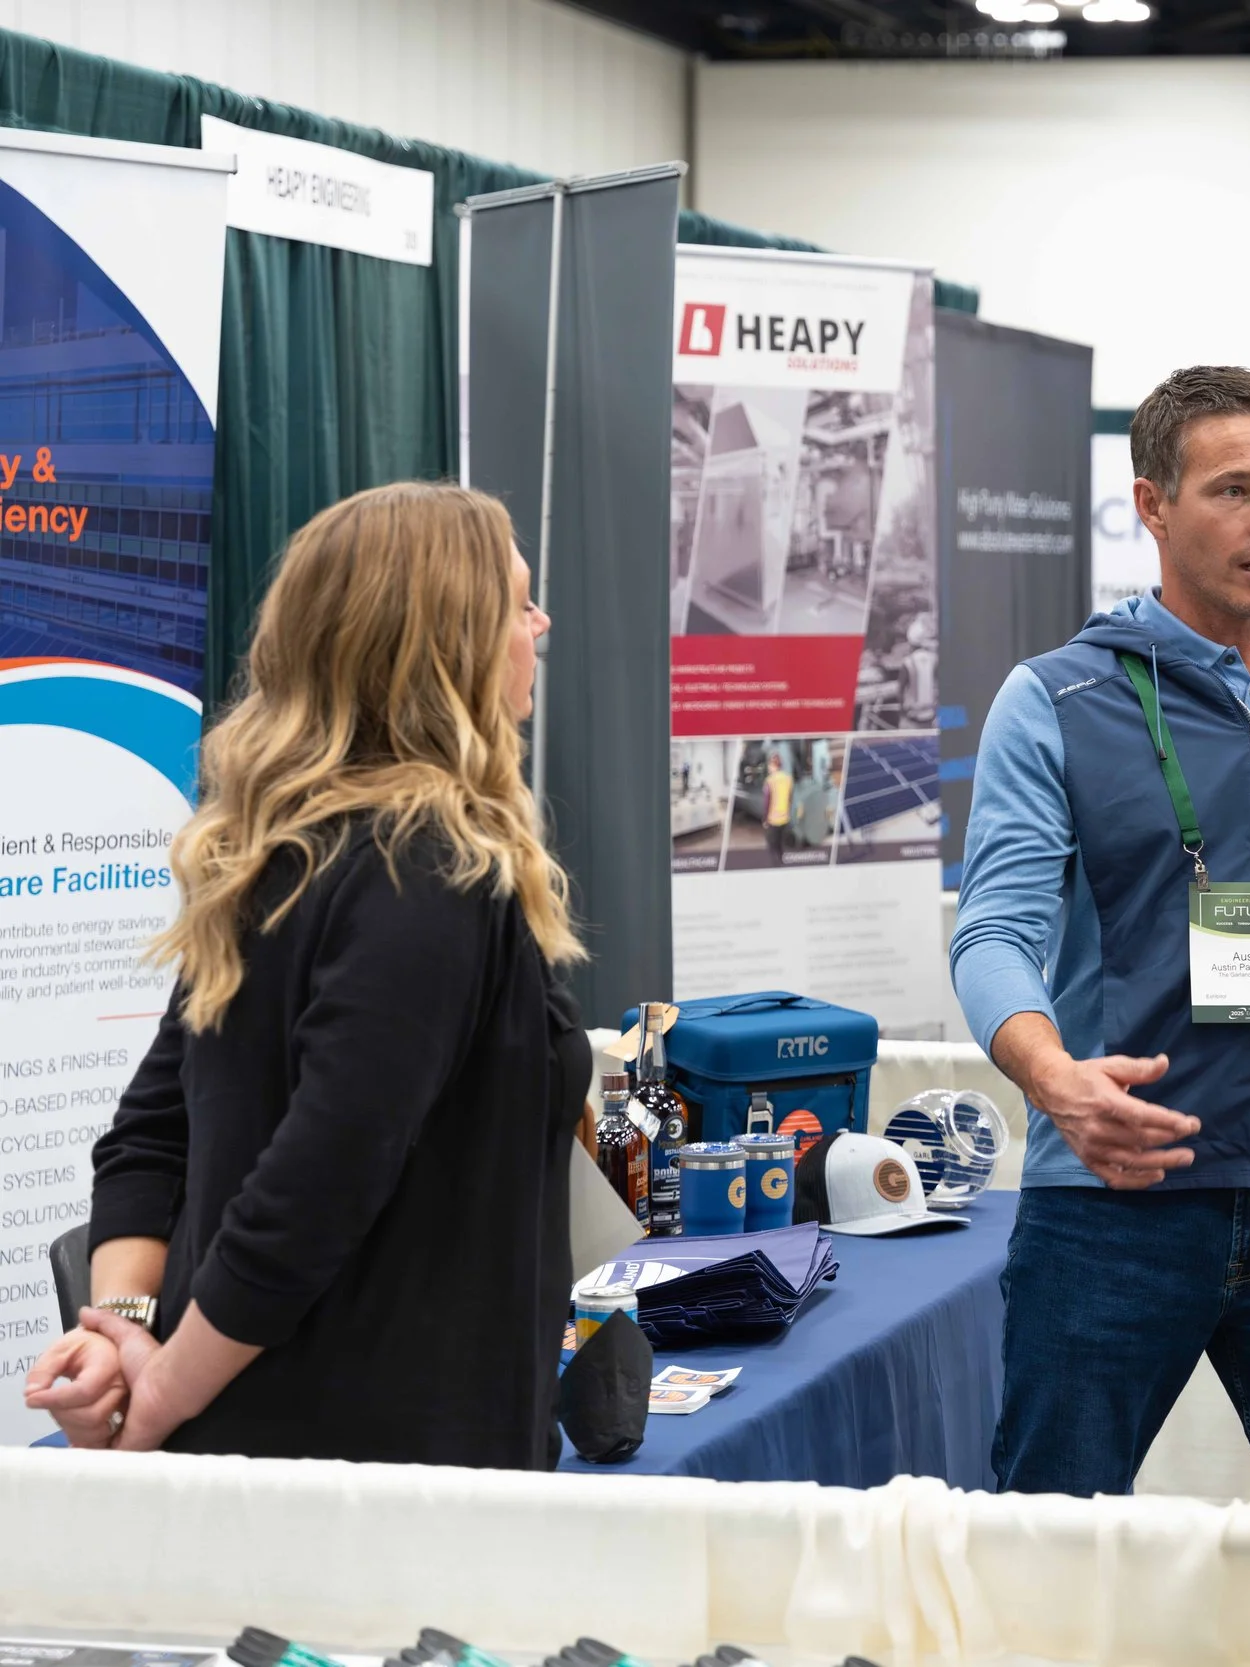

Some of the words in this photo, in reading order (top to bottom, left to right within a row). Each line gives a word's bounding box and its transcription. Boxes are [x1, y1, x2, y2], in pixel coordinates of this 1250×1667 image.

[267, 166, 306, 199] HEAPY
[737, 314, 865, 355] HEAPY
[786, 356, 858, 373] SOLUTIONS
[33, 447, 57, 483] &
[43, 833, 55, 853] &
[61, 828, 173, 854] Responsible
[53, 862, 171, 894] Facilities
[57, 921, 69, 935] to
[72, 919, 114, 934] energy
[118, 914, 166, 931] savings
[22, 960, 81, 979] industry's
[1211, 963, 1237, 972] Austin
[26, 982, 52, 998] and
[55, 979, 95, 999] patient
[777, 1035, 829, 1059] RTIC
[47, 1056, 57, 1075] &
[61, 1049, 128, 1072] FINISHES
[2, 1164, 76, 1191] SYSTEMS
[2, 1199, 89, 1229] SOLUTIONS
